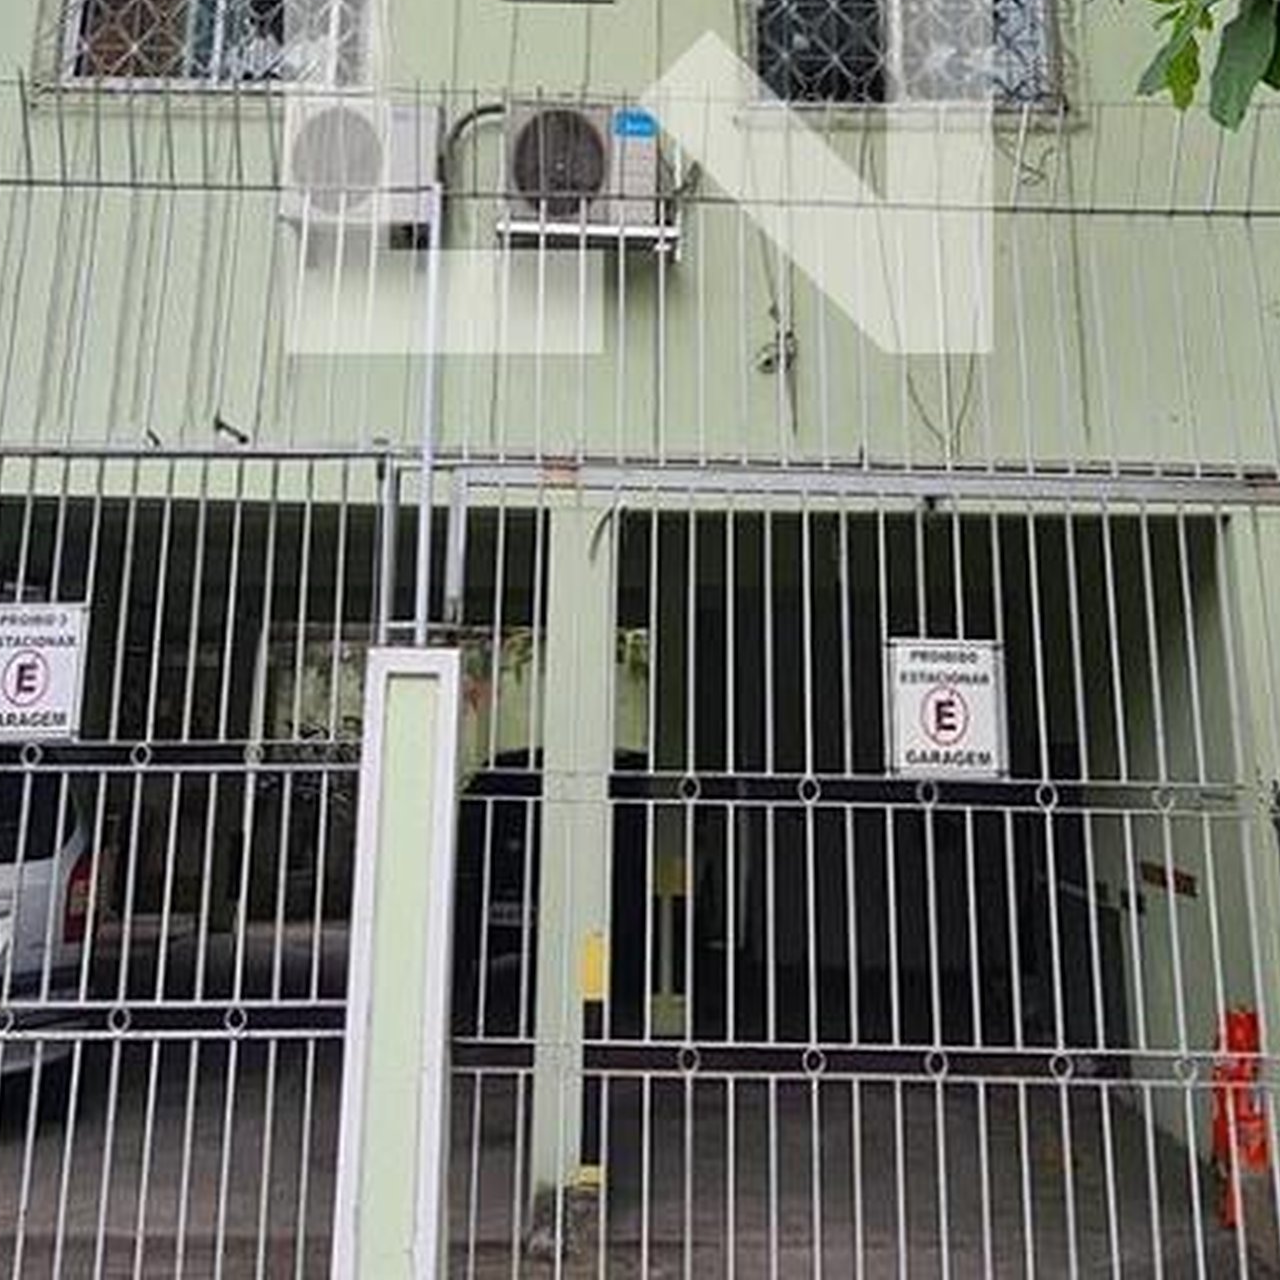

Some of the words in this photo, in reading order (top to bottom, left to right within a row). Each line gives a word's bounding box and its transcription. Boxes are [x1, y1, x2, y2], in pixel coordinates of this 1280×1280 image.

[910, 650, 977, 664] PROIBIDO
[16, 663, 39, 694] E
[936, 699, 957, 732] E
[906, 749, 991, 765] GARAGEM
